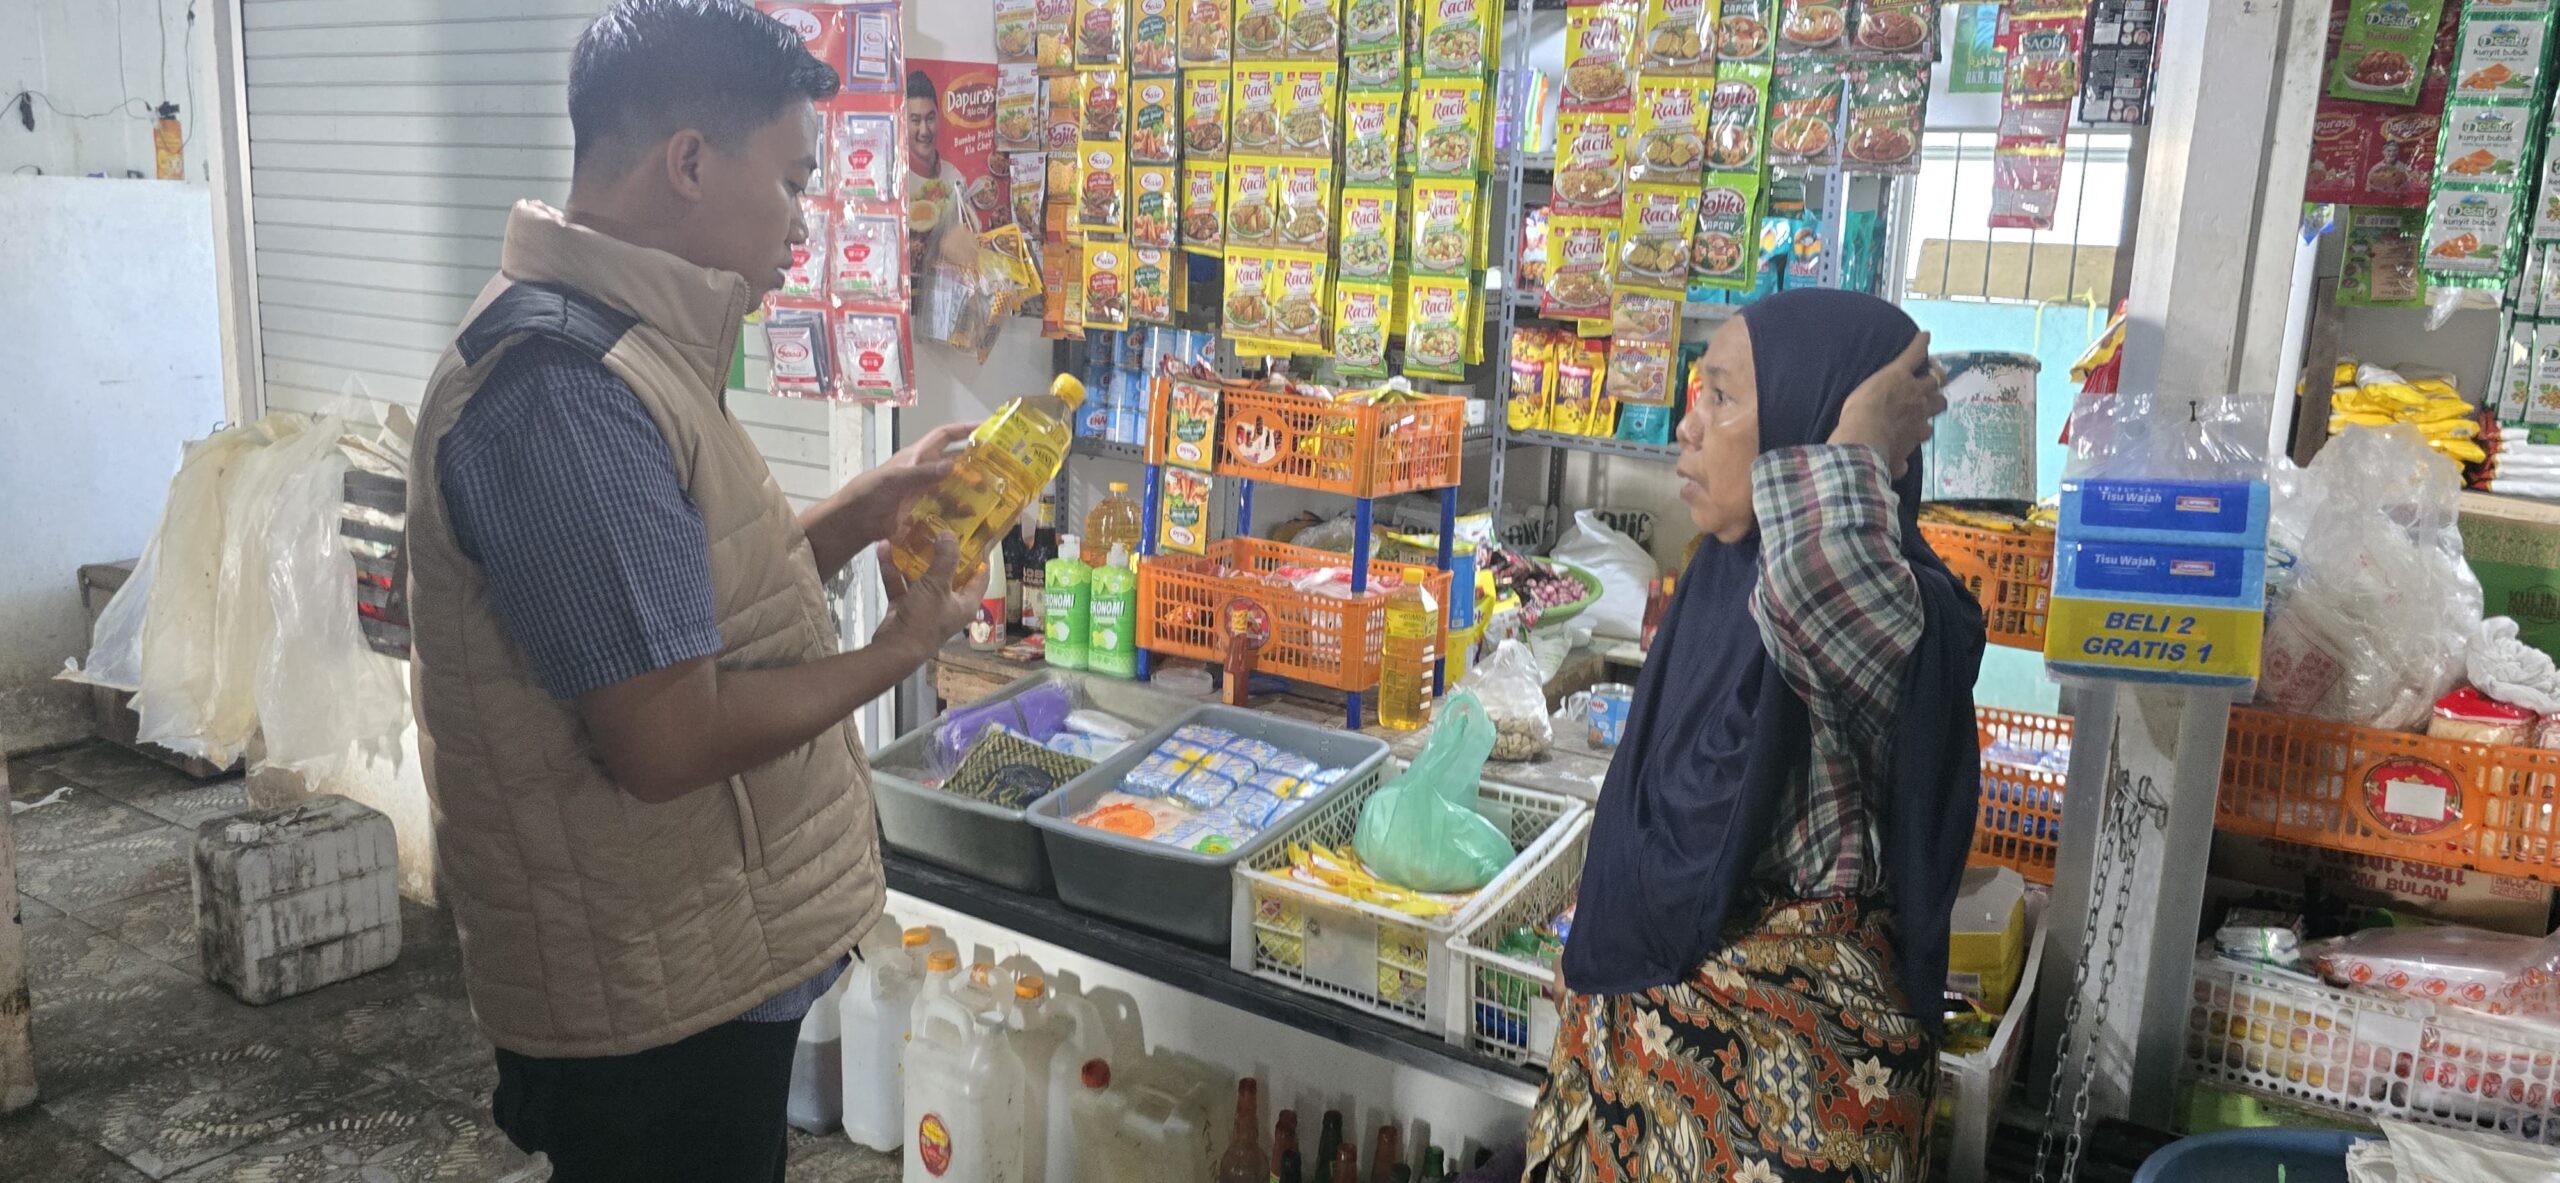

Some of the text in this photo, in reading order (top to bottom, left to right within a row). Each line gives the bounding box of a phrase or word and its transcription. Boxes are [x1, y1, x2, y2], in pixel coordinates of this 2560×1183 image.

[2367, 12, 2420, 29] Desaku
[1580, 29, 1622, 49] Raik
[2477, 34, 2531, 48] Desaku
[2473, 46, 2530, 60] kunyit bubuk
[1192, 89, 1220, 107] Racik
[1243, 82, 1272, 100] Racik
[1293, 82, 1323, 100] Racik
[947, 86, 995, 115] Dapura's
[1433, 101, 1468, 120] Racik
[1652, 103, 1695, 120] Racik
[1353, 113, 1385, 131] Racik
[2461, 119, 2514, 133] Desaku
[1048, 126, 1078, 148] Sajik
[2457, 133, 2513, 145] kunyit bubuk
[1192, 178, 1214, 197] Racik
[1239, 176, 1268, 193] Racik
[1288, 178, 1318, 196] Racik
[1351, 209, 1383, 228] Racik
[1639, 207, 1684, 225] Racik
[2447, 203, 2499, 218] Desaku
[2443, 216, 2497, 230] kunyit bubuk
[1562, 236, 1605, 257] Racik
[1235, 267, 1264, 284] Racik
[1284, 271, 1314, 288] Racik
[1343, 303, 1378, 321] Racik
[1420, 299, 1455, 316] Racik
[2101, 490, 2162, 505] Tisu Wajah
[2095, 553, 2156, 568] Tisu Wajah
[1091, 600, 1126, 618] EKONOMI
[2104, 611, 2196, 635] BELI 2
[2082, 636, 2213, 664] GRATIS 1
[2385, 877, 2449, 902] BULAN
